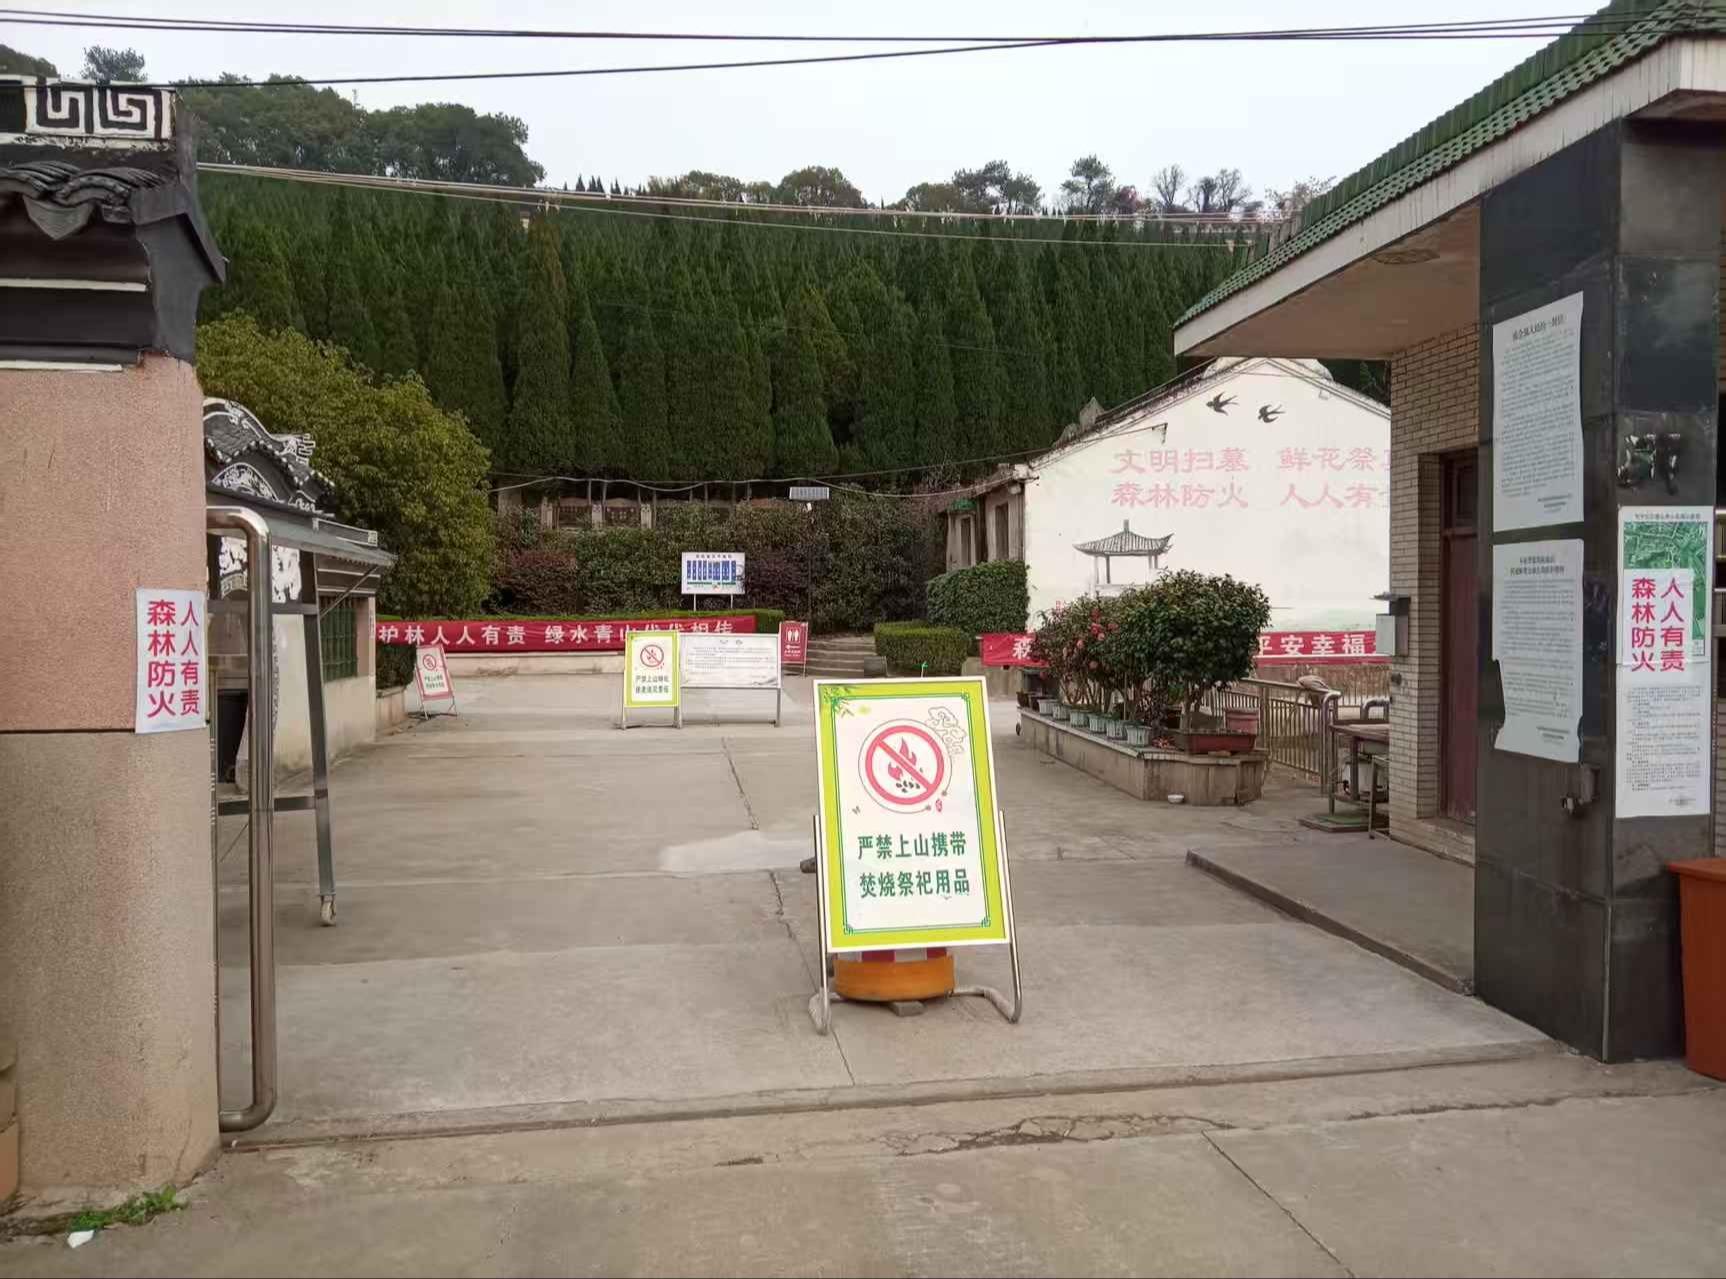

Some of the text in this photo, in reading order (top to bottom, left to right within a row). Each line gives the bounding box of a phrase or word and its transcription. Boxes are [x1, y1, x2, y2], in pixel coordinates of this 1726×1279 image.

[1109, 447, 1390, 473] 文明扫墓 鲜花祭
[1111, 475, 1390, 509] 森林防火 人人有
[378, 624, 527, 646] 护林人人有责
[1631, 577, 1656, 672] 森林防火
[1660, 577, 1686, 672] 人人有责
[147, 600, 177, 718] 森林防火
[180, 600, 200, 716] 人人有责
[1257, 633, 1376, 656] 平安幸福
[857, 831, 967, 860] 严禁上山携带
[859, 868, 970, 898] 焚烧祭祀用品
